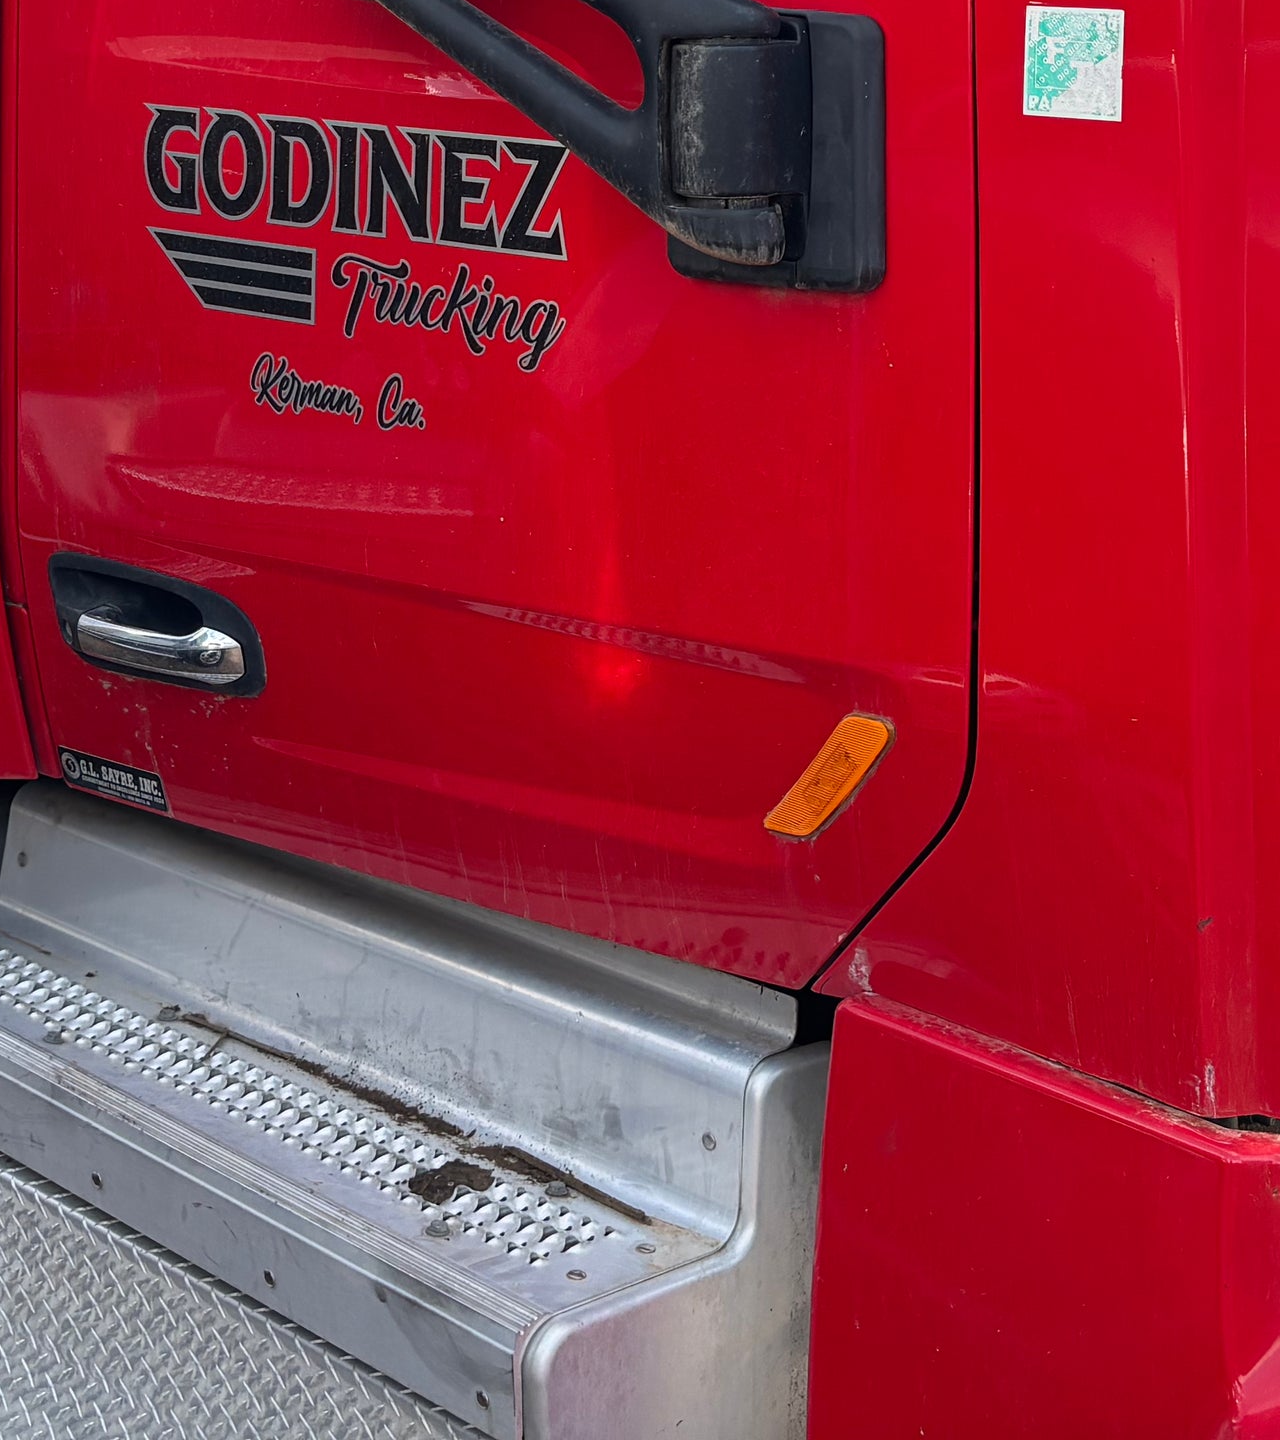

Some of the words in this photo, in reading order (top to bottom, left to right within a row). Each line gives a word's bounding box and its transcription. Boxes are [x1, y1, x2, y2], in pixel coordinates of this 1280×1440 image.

[143, 102, 568, 261] GODINEZ
[331, 253, 565, 372] Trucking
[250, 351, 363, 423] Kerman,
[376, 372, 426, 431] Ca.
[80, 759, 99, 778] G.L.
[100, 765, 138, 791] SAYRE,
[139, 776, 162, 796] INC.
